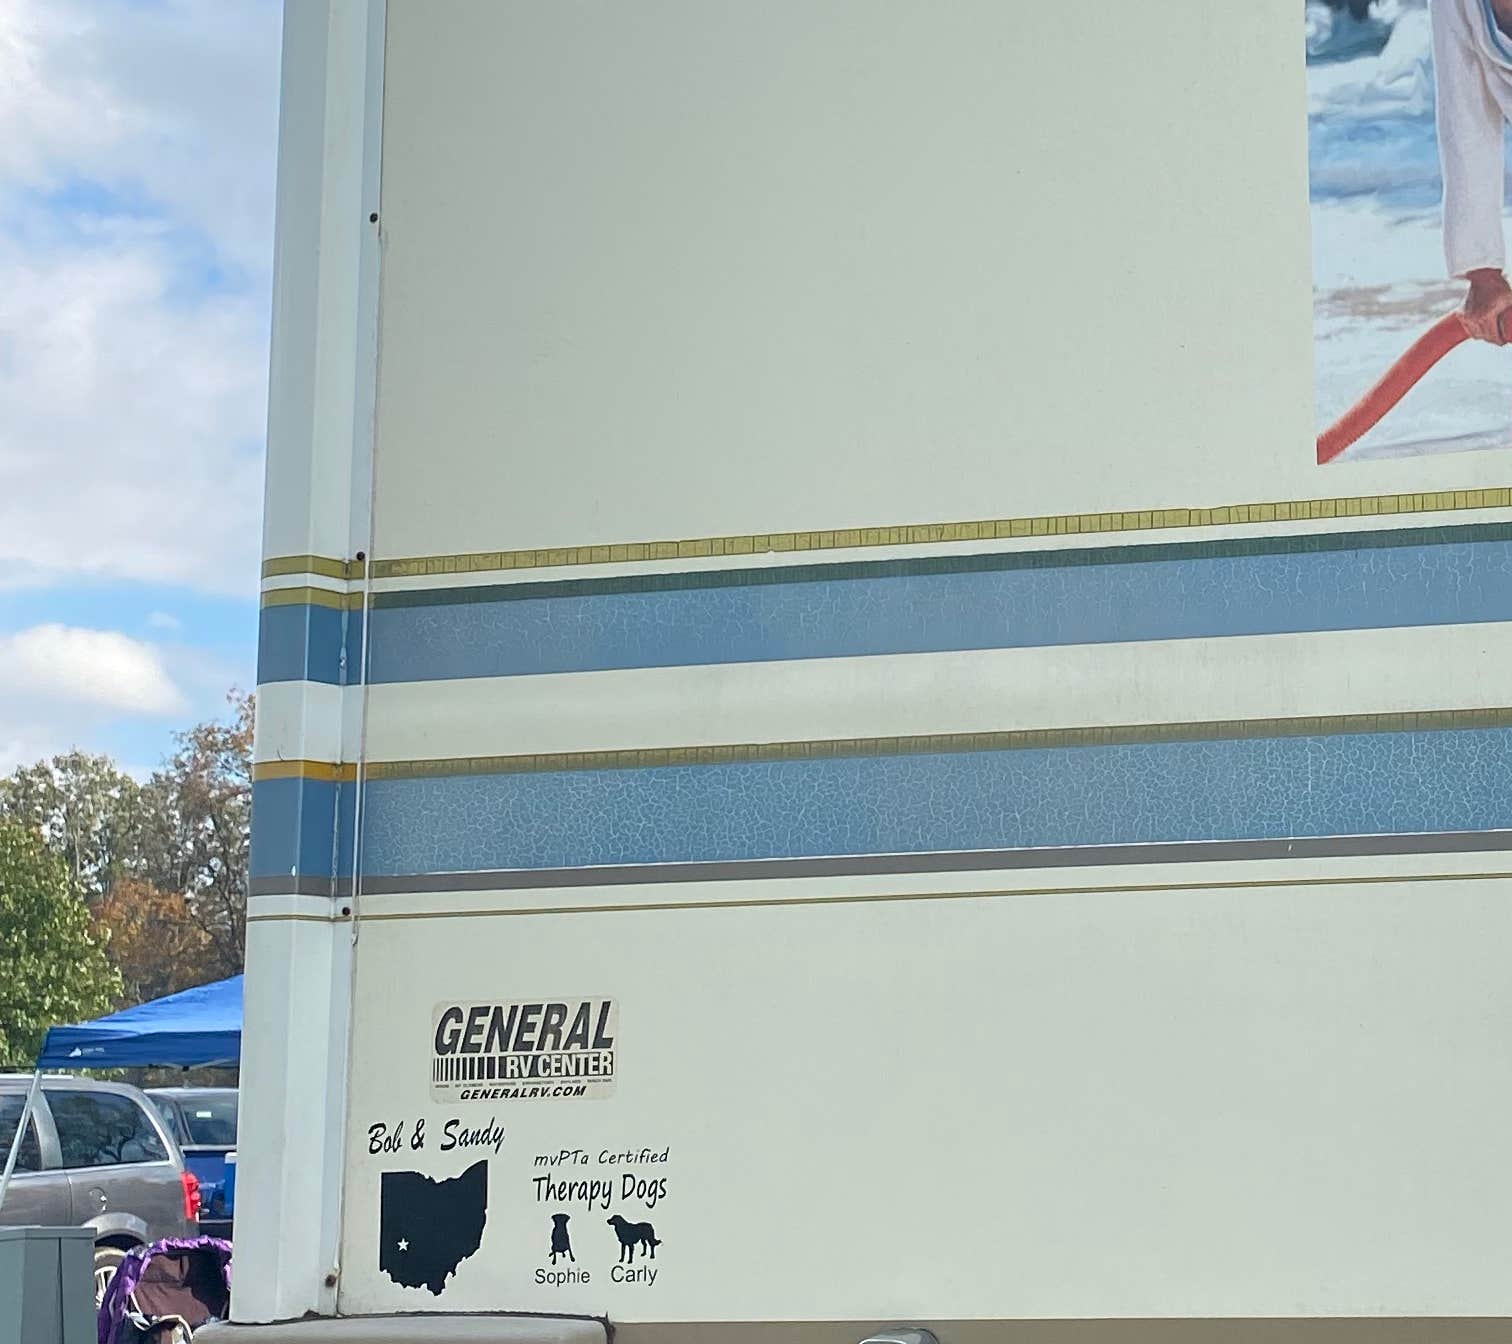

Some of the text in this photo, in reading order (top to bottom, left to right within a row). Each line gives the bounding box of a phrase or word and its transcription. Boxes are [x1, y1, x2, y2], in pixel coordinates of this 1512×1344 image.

[434, 1000, 615, 1056] GENERAL
[505, 1051, 613, 1079] RV CENTER
[460, 1085, 587, 1100] GENERALRV.COM
[368, 1116, 505, 1155] Bob & Sandy
[598, 1146, 670, 1164] Certified
[532, 1172, 667, 1212] Therapy Dogs
[534, 1265, 658, 1287] Sophie Carly
